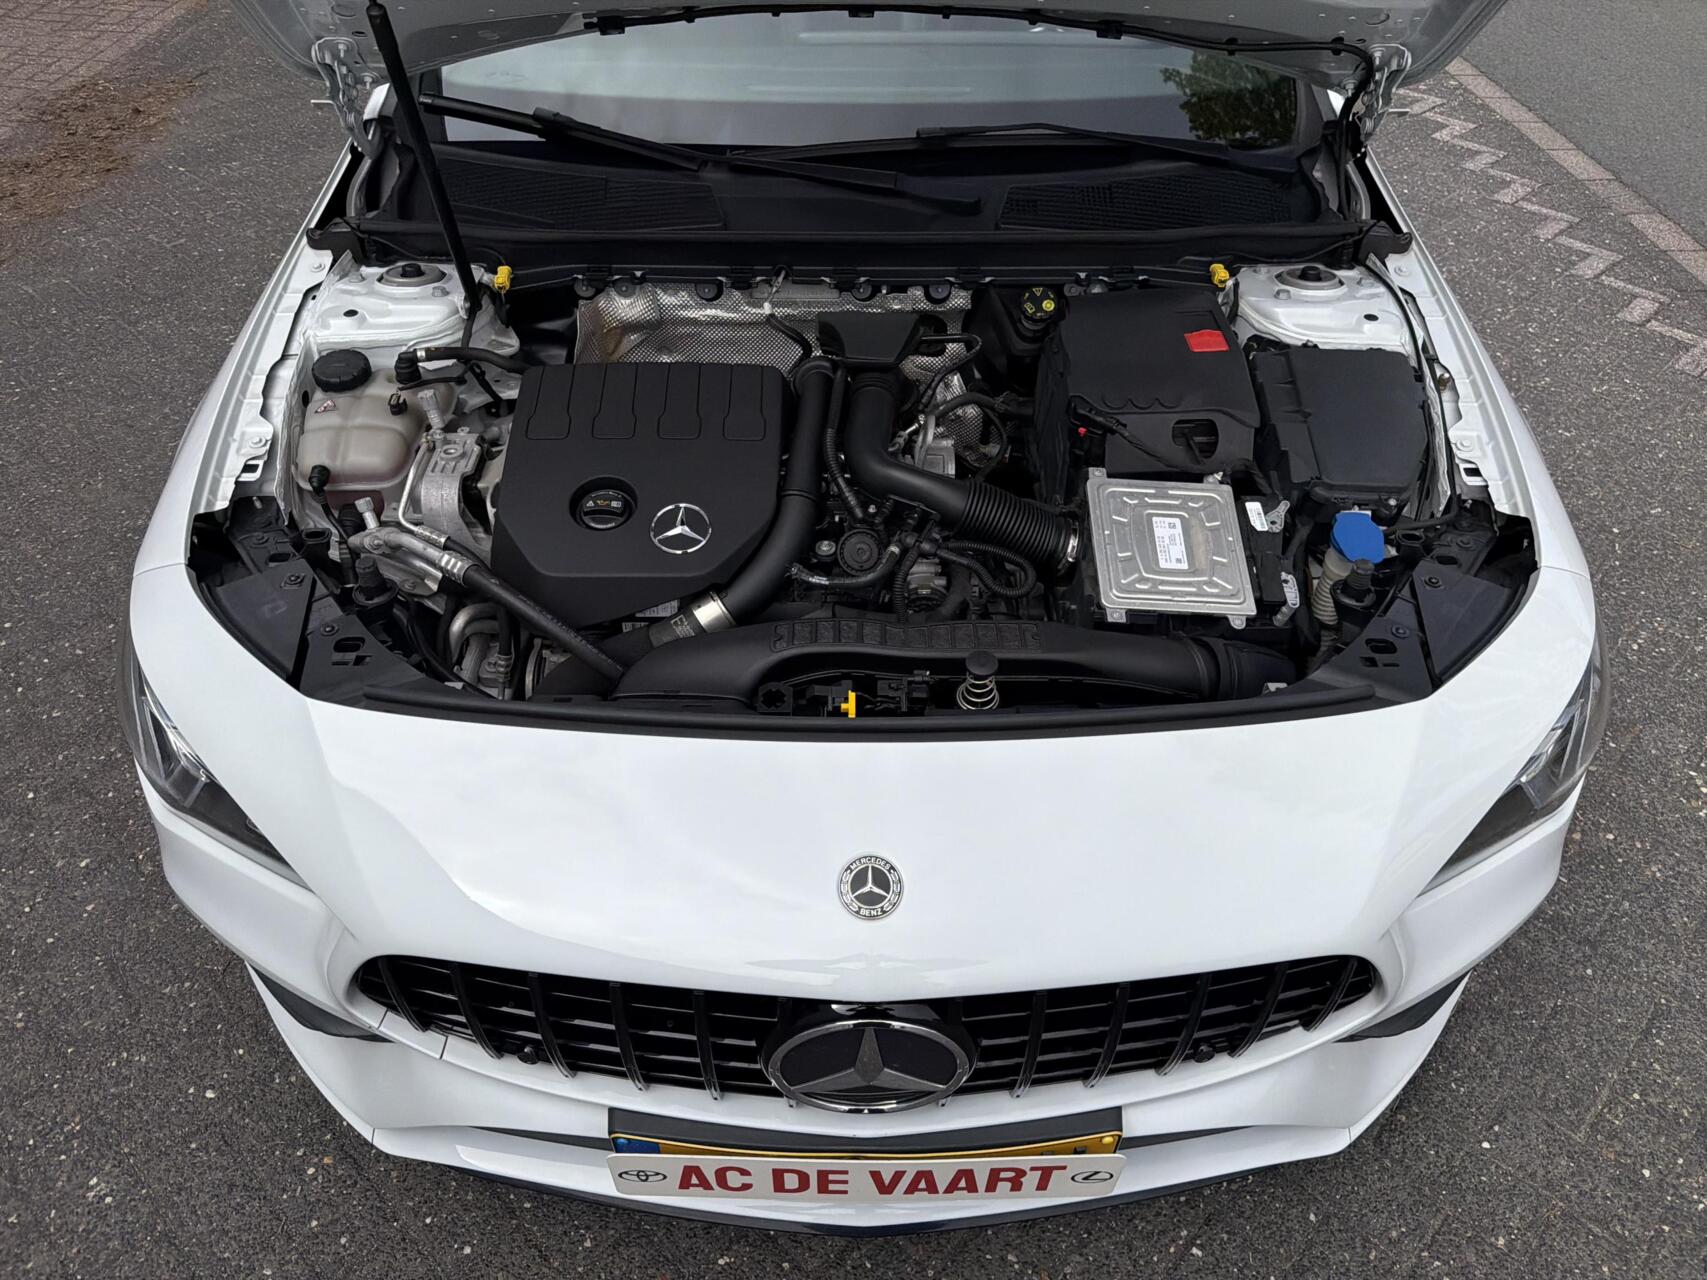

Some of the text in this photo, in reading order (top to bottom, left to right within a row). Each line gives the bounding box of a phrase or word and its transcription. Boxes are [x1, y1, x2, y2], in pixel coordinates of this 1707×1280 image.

[850, 857, 891, 870] MERCEDES
[860, 908, 882, 916] BENZ
[678, 1165, 1067, 1195] AC DE VAART
